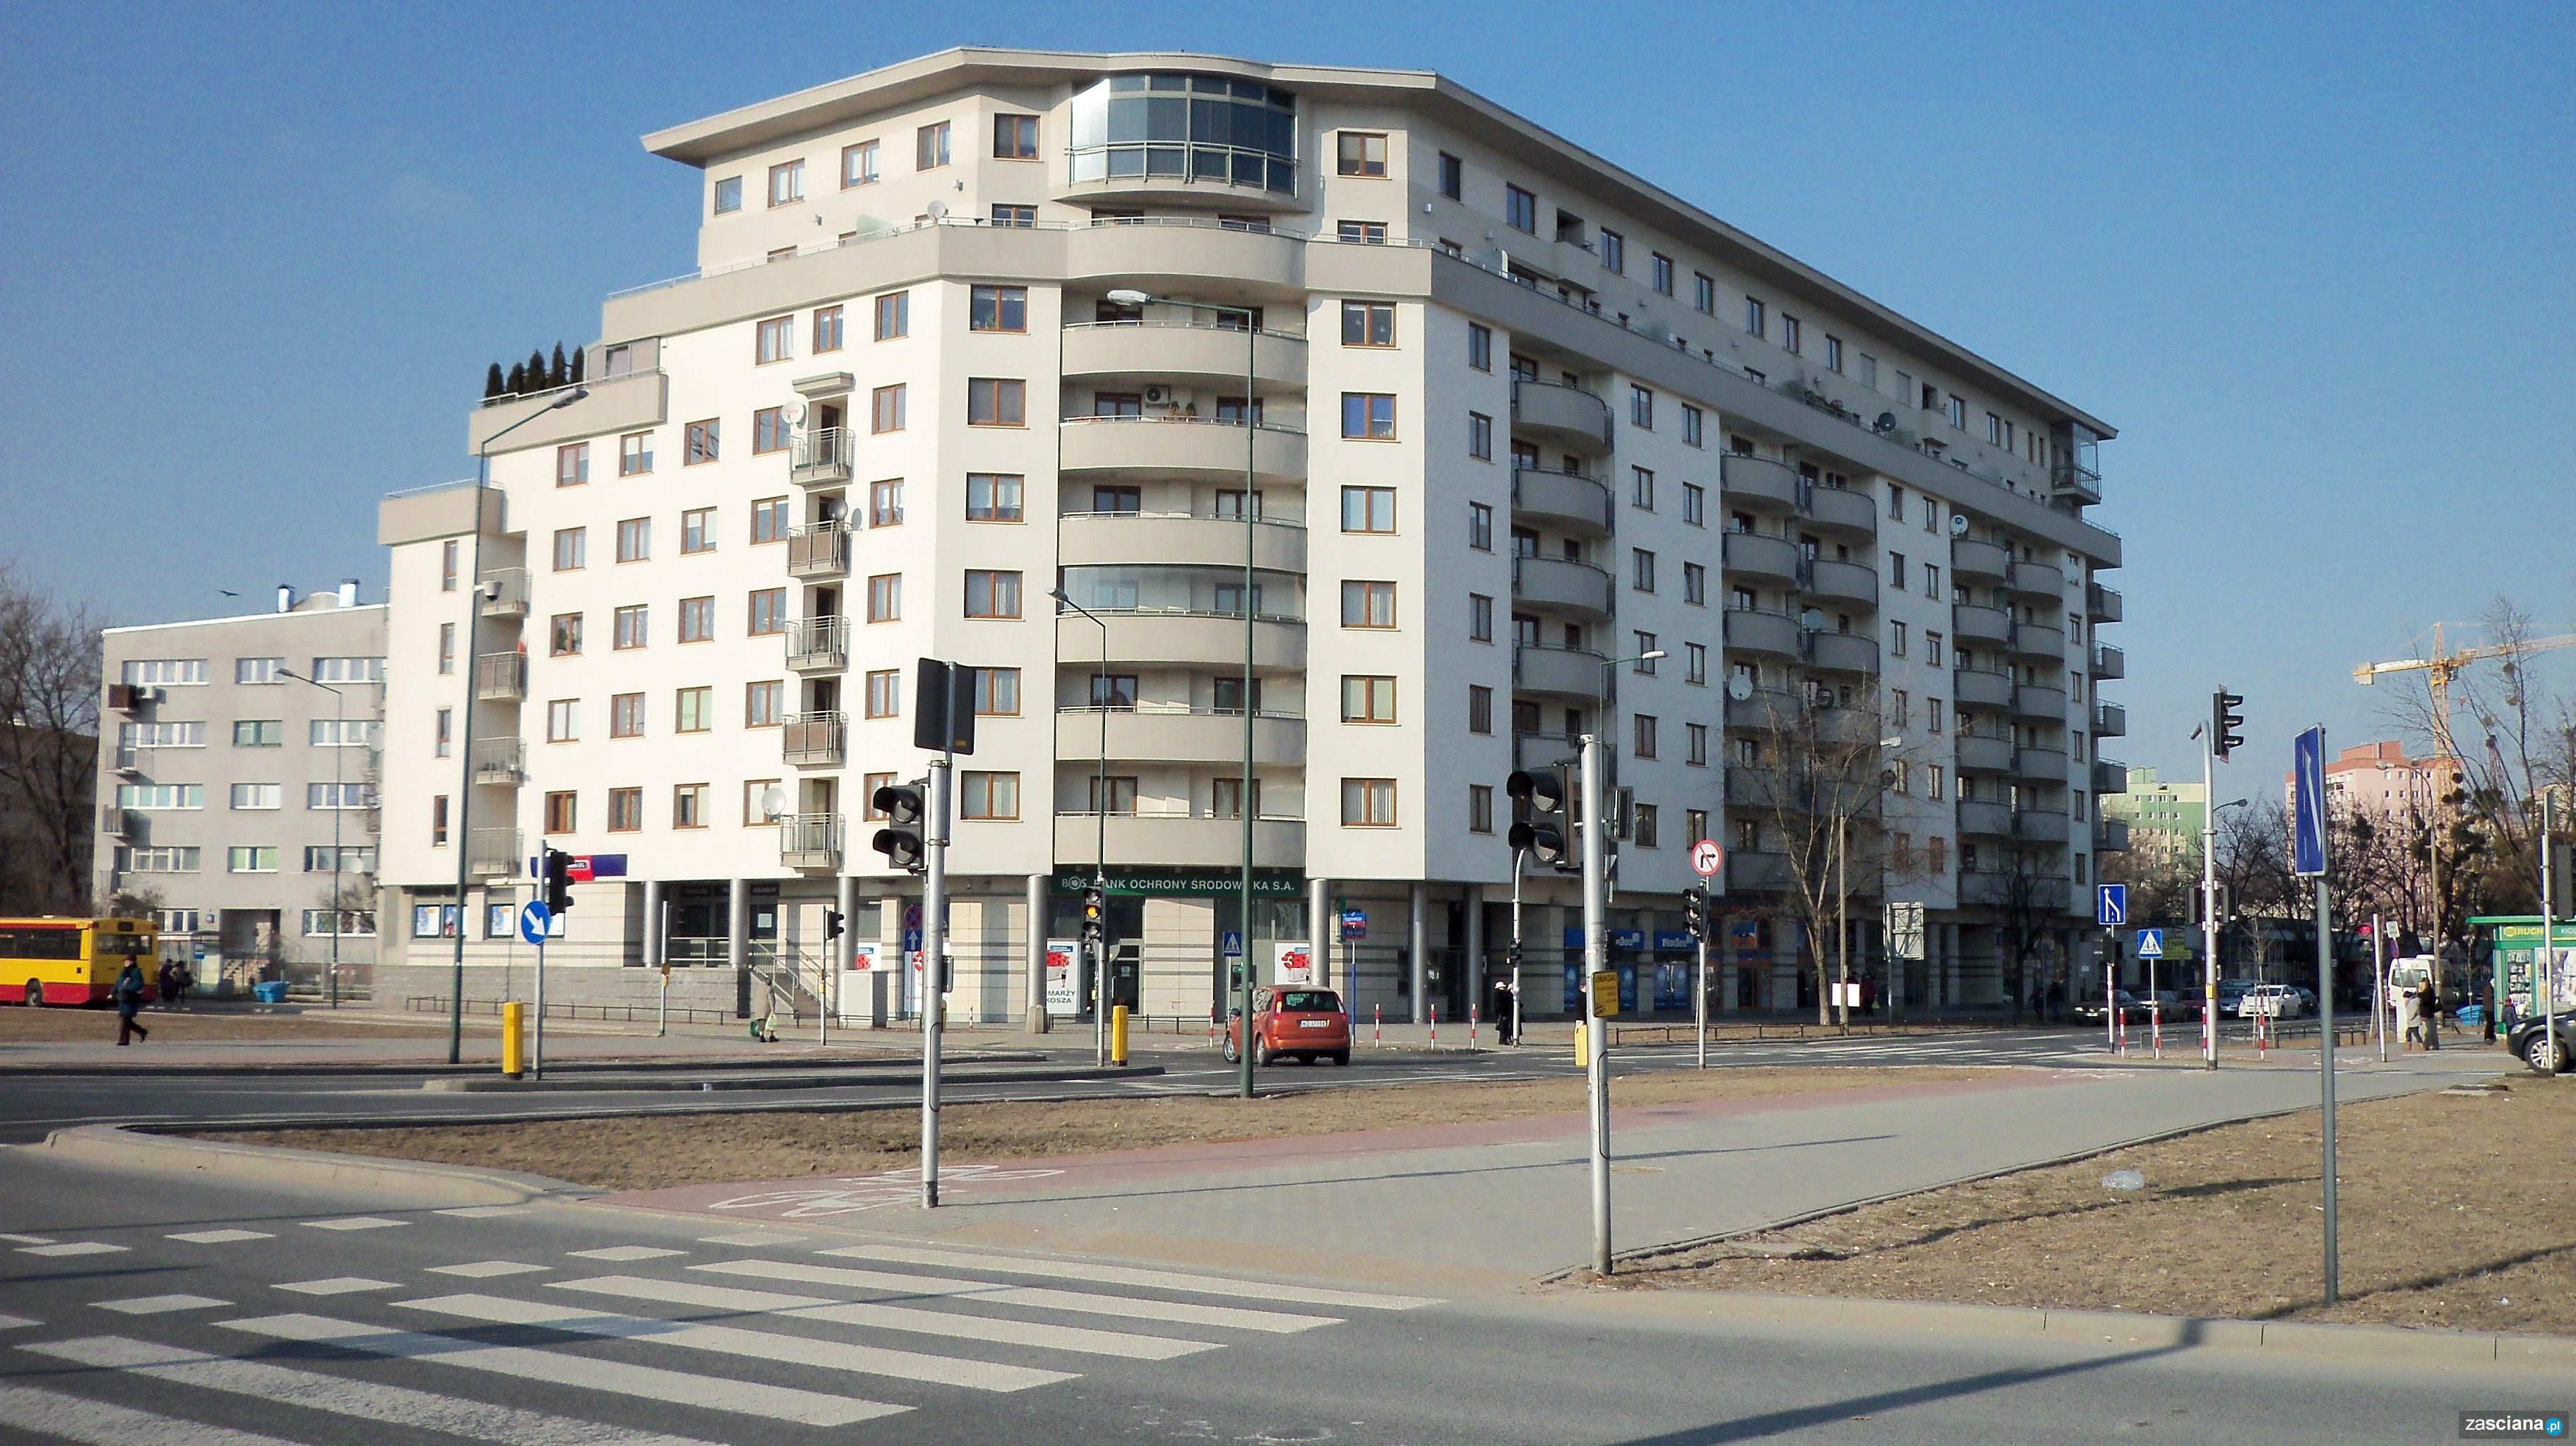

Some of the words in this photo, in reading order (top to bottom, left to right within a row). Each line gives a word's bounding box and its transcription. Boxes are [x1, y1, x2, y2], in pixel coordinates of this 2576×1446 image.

[1130, 880, 1186, 889] OCHRONY
[1191, 878, 1268, 890] ŚRODOWKA
[1272, 882, 1294, 890] S.A.
